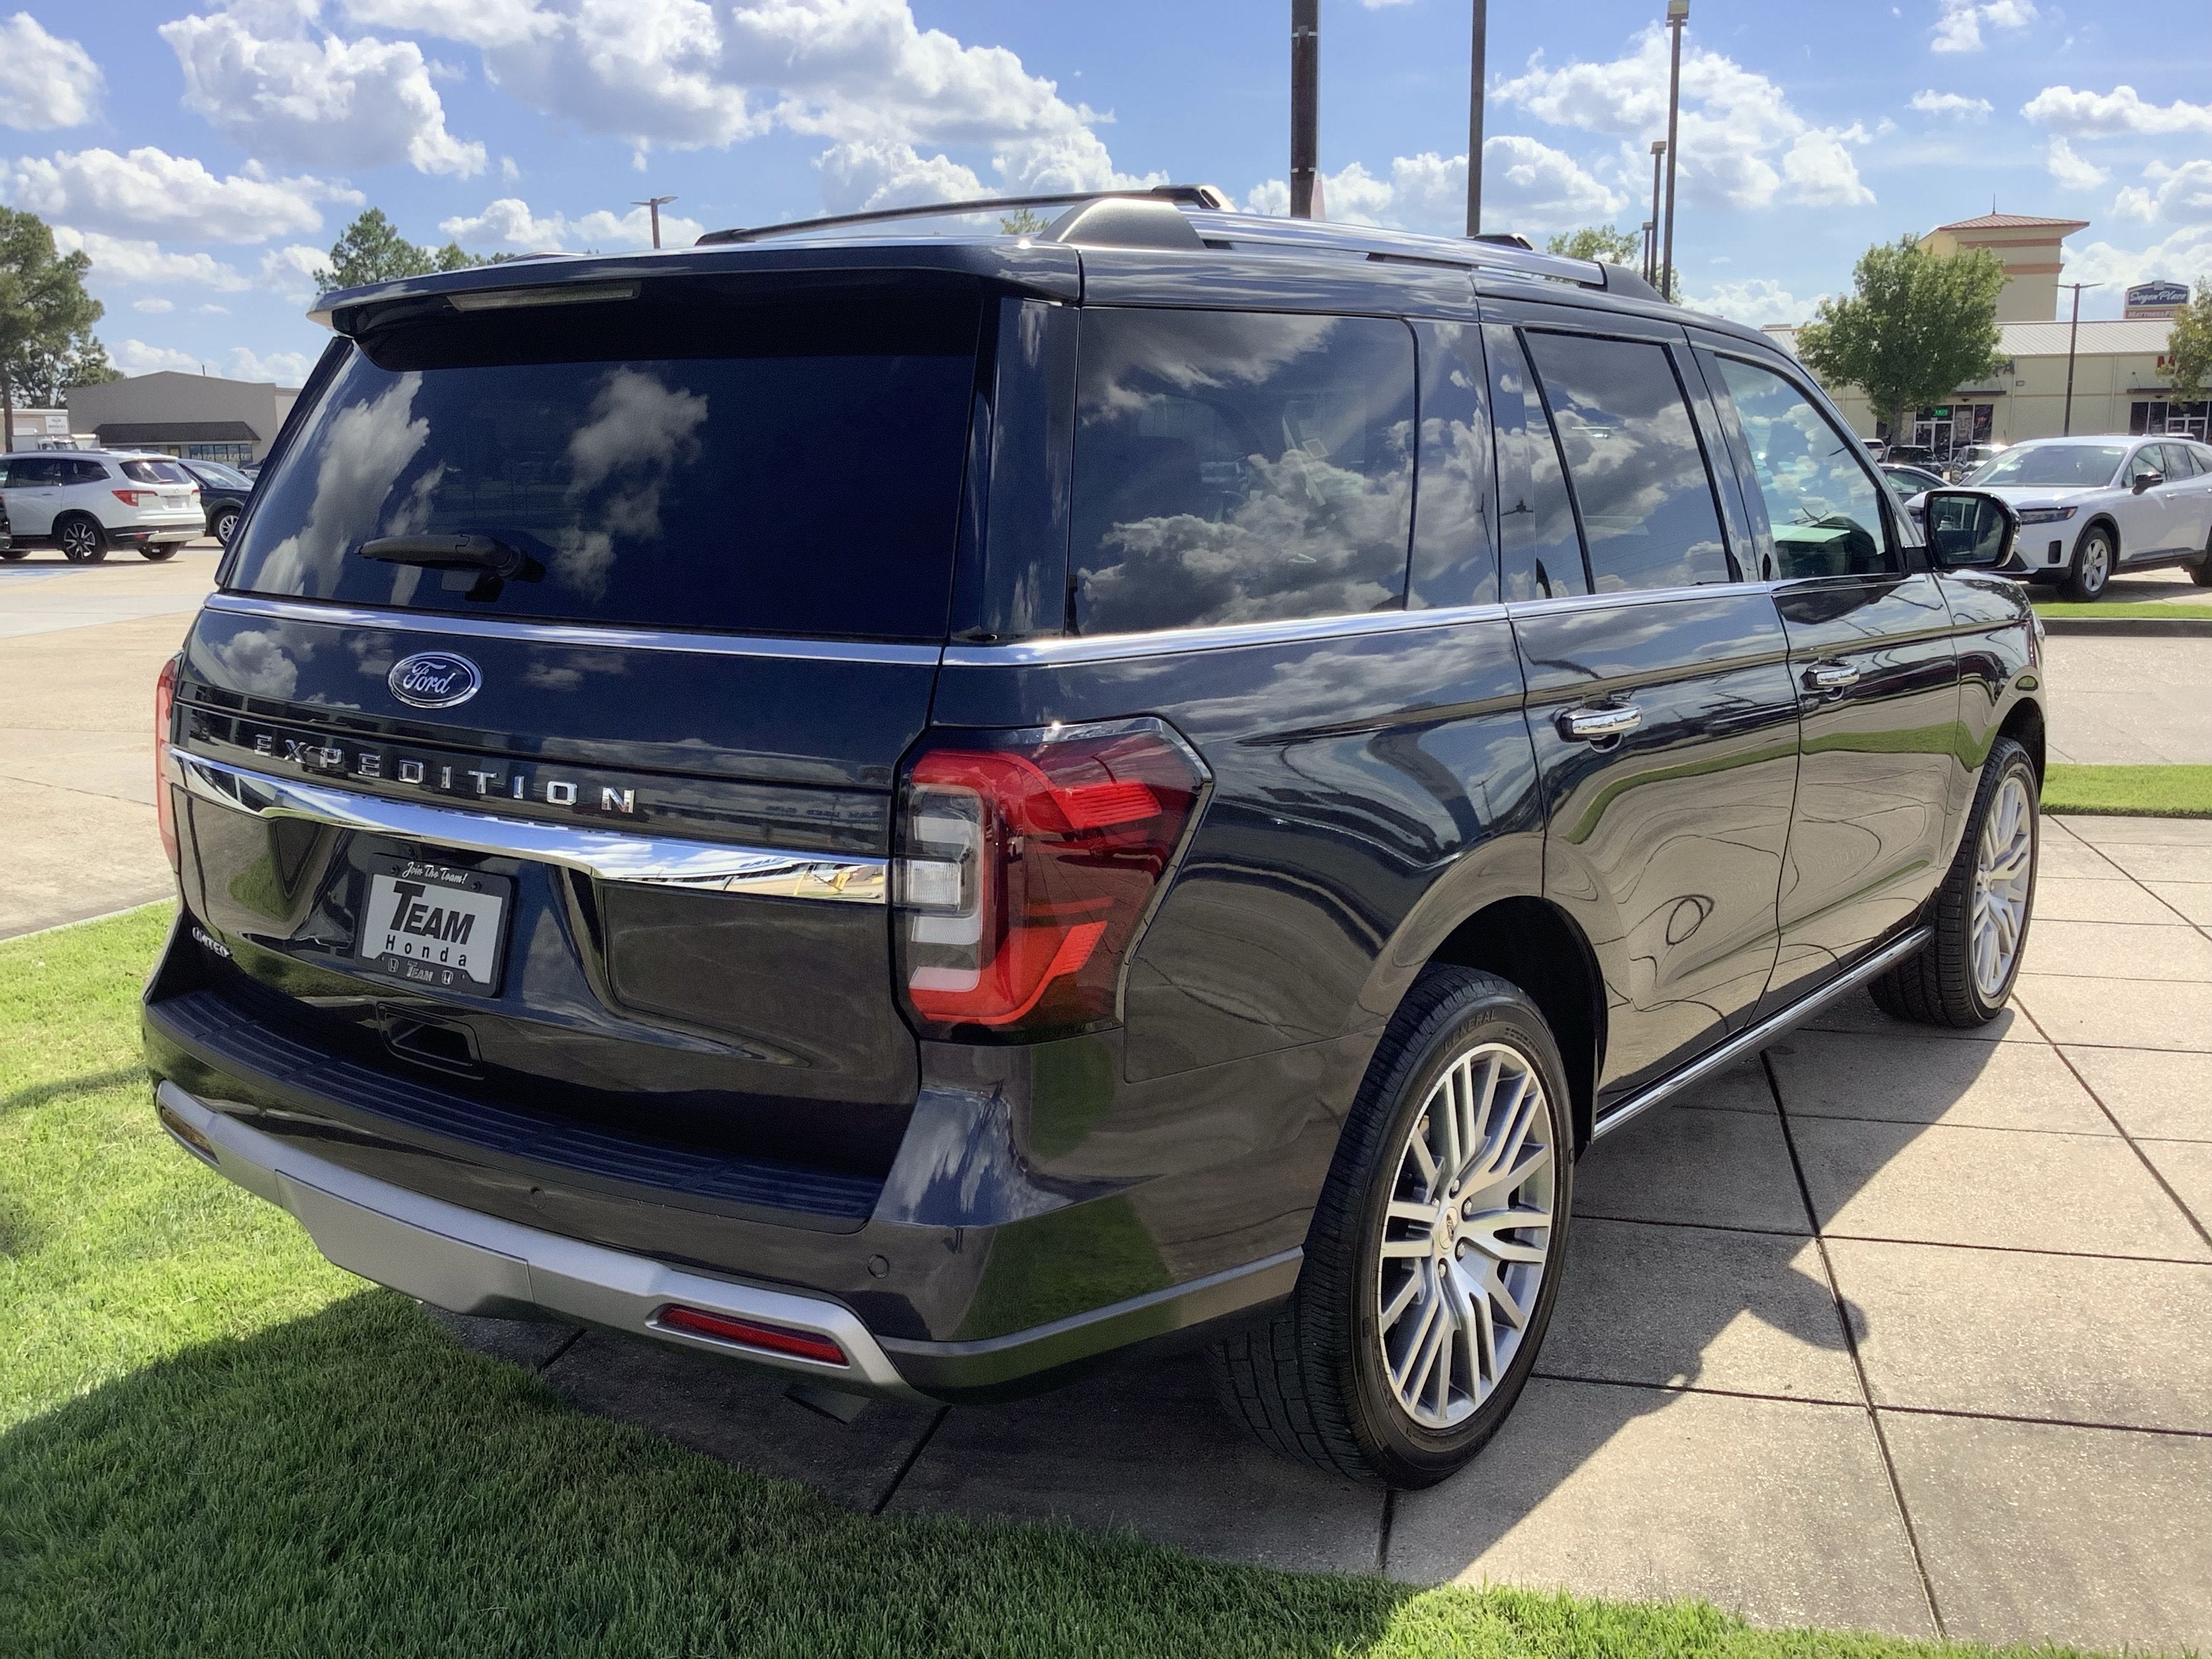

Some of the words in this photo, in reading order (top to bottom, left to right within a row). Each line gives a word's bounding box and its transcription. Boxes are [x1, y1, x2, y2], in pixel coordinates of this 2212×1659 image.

[2158, 290, 2187, 301] Place
[403, 661, 456, 694] Ford
[253, 733, 636, 814] EXPEDITION
[401, 861, 424, 878] Join
[424, 864, 439, 878] The
[440, 867, 468, 884] Team!
[389, 880, 476, 945] TEAM
[385, 934, 467, 967] Honda
